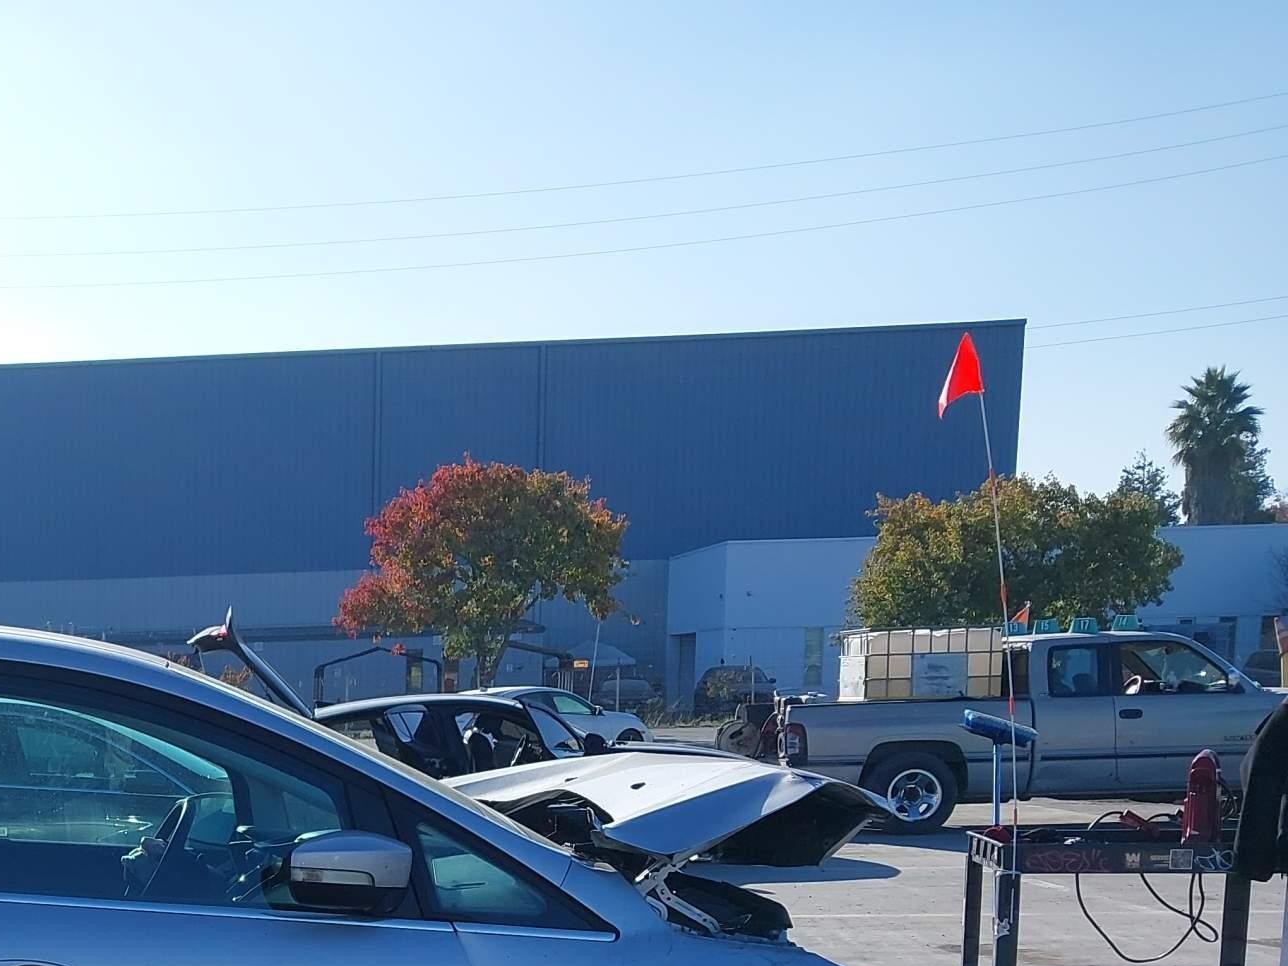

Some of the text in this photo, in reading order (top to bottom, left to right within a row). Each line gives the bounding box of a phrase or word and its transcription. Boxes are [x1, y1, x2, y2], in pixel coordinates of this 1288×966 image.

[1009, 622, 1019, 633] 13
[1040, 621, 1049, 631] 15
[1080, 620, 1089, 630] 17
